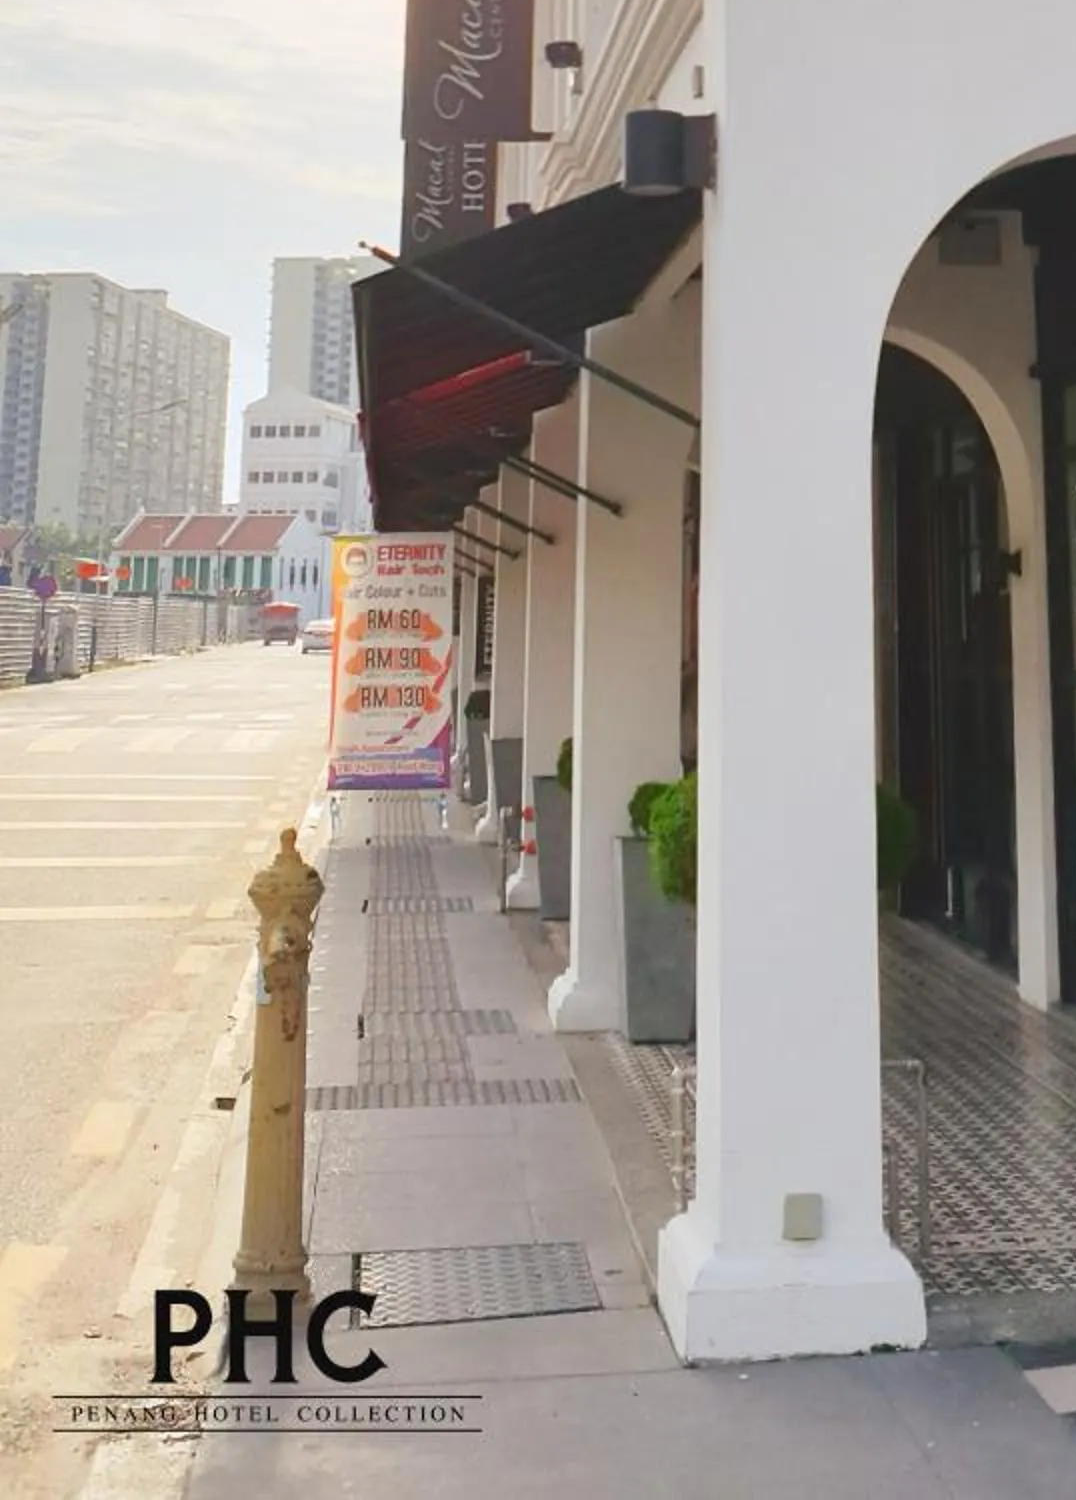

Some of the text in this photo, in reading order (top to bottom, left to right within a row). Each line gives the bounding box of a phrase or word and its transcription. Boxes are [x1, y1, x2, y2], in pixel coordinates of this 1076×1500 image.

[377, 544, 446, 561] ETERNITY
[367, 609, 421, 629] RM 60
[365, 648, 421, 669] RM 90
[361, 687, 425, 708] RM 130
